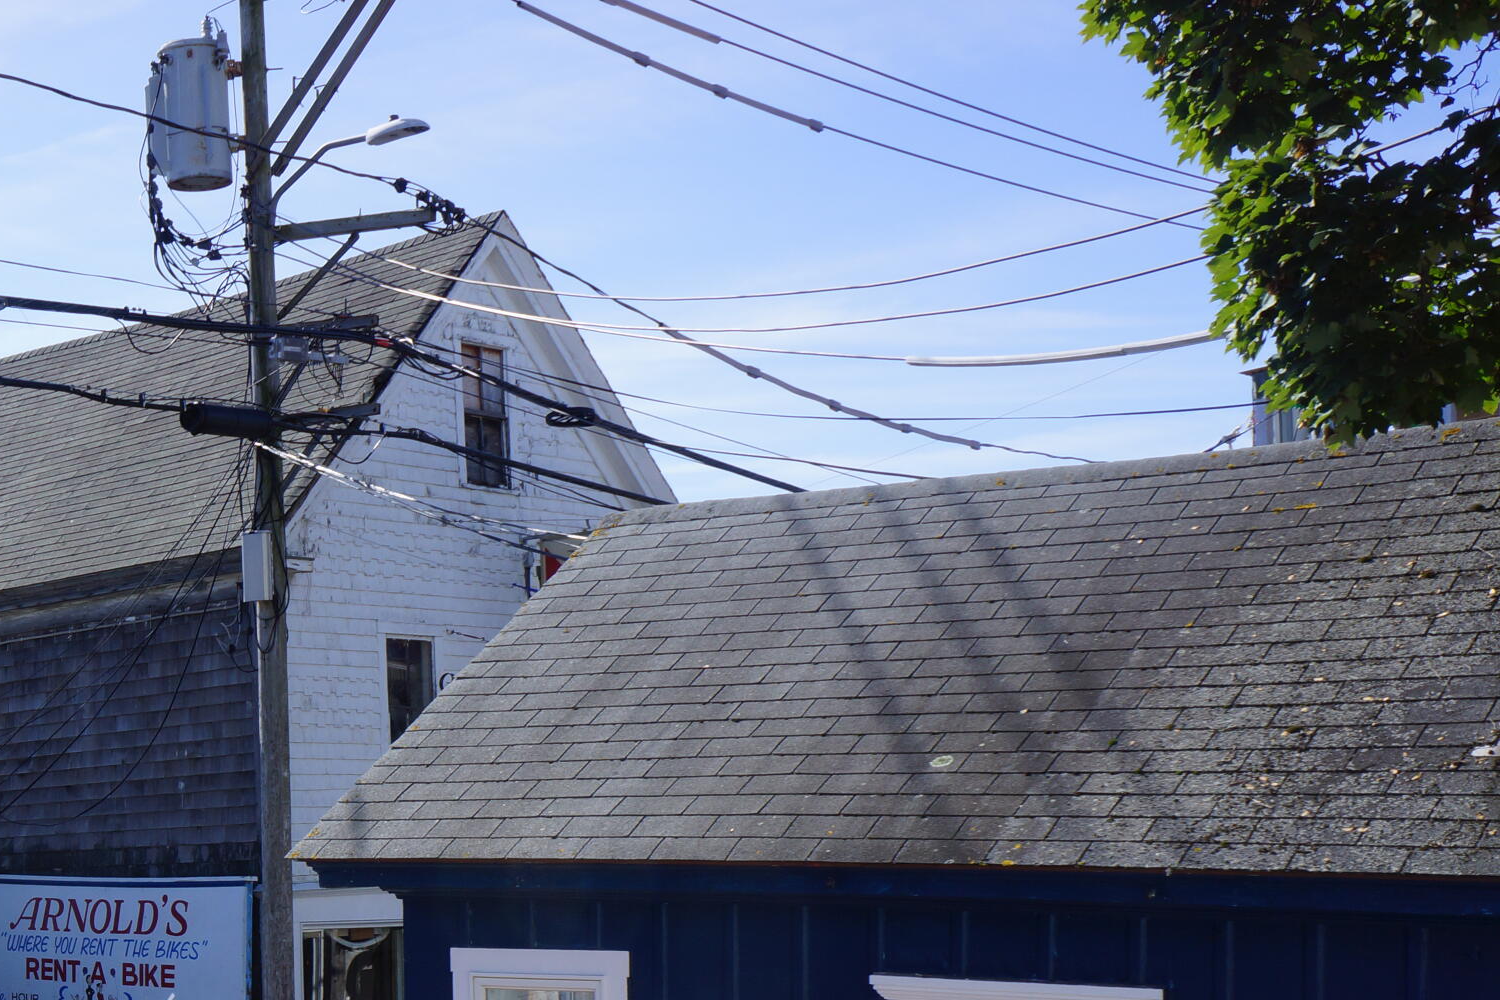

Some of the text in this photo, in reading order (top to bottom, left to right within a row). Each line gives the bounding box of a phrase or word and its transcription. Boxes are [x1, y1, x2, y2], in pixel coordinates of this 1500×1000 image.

[10, 894, 188, 936] ARNOLD'S
[54, 936, 77, 955] YOU
[80, 938, 119, 956] RENT
[123, 939, 152, 957] THE
